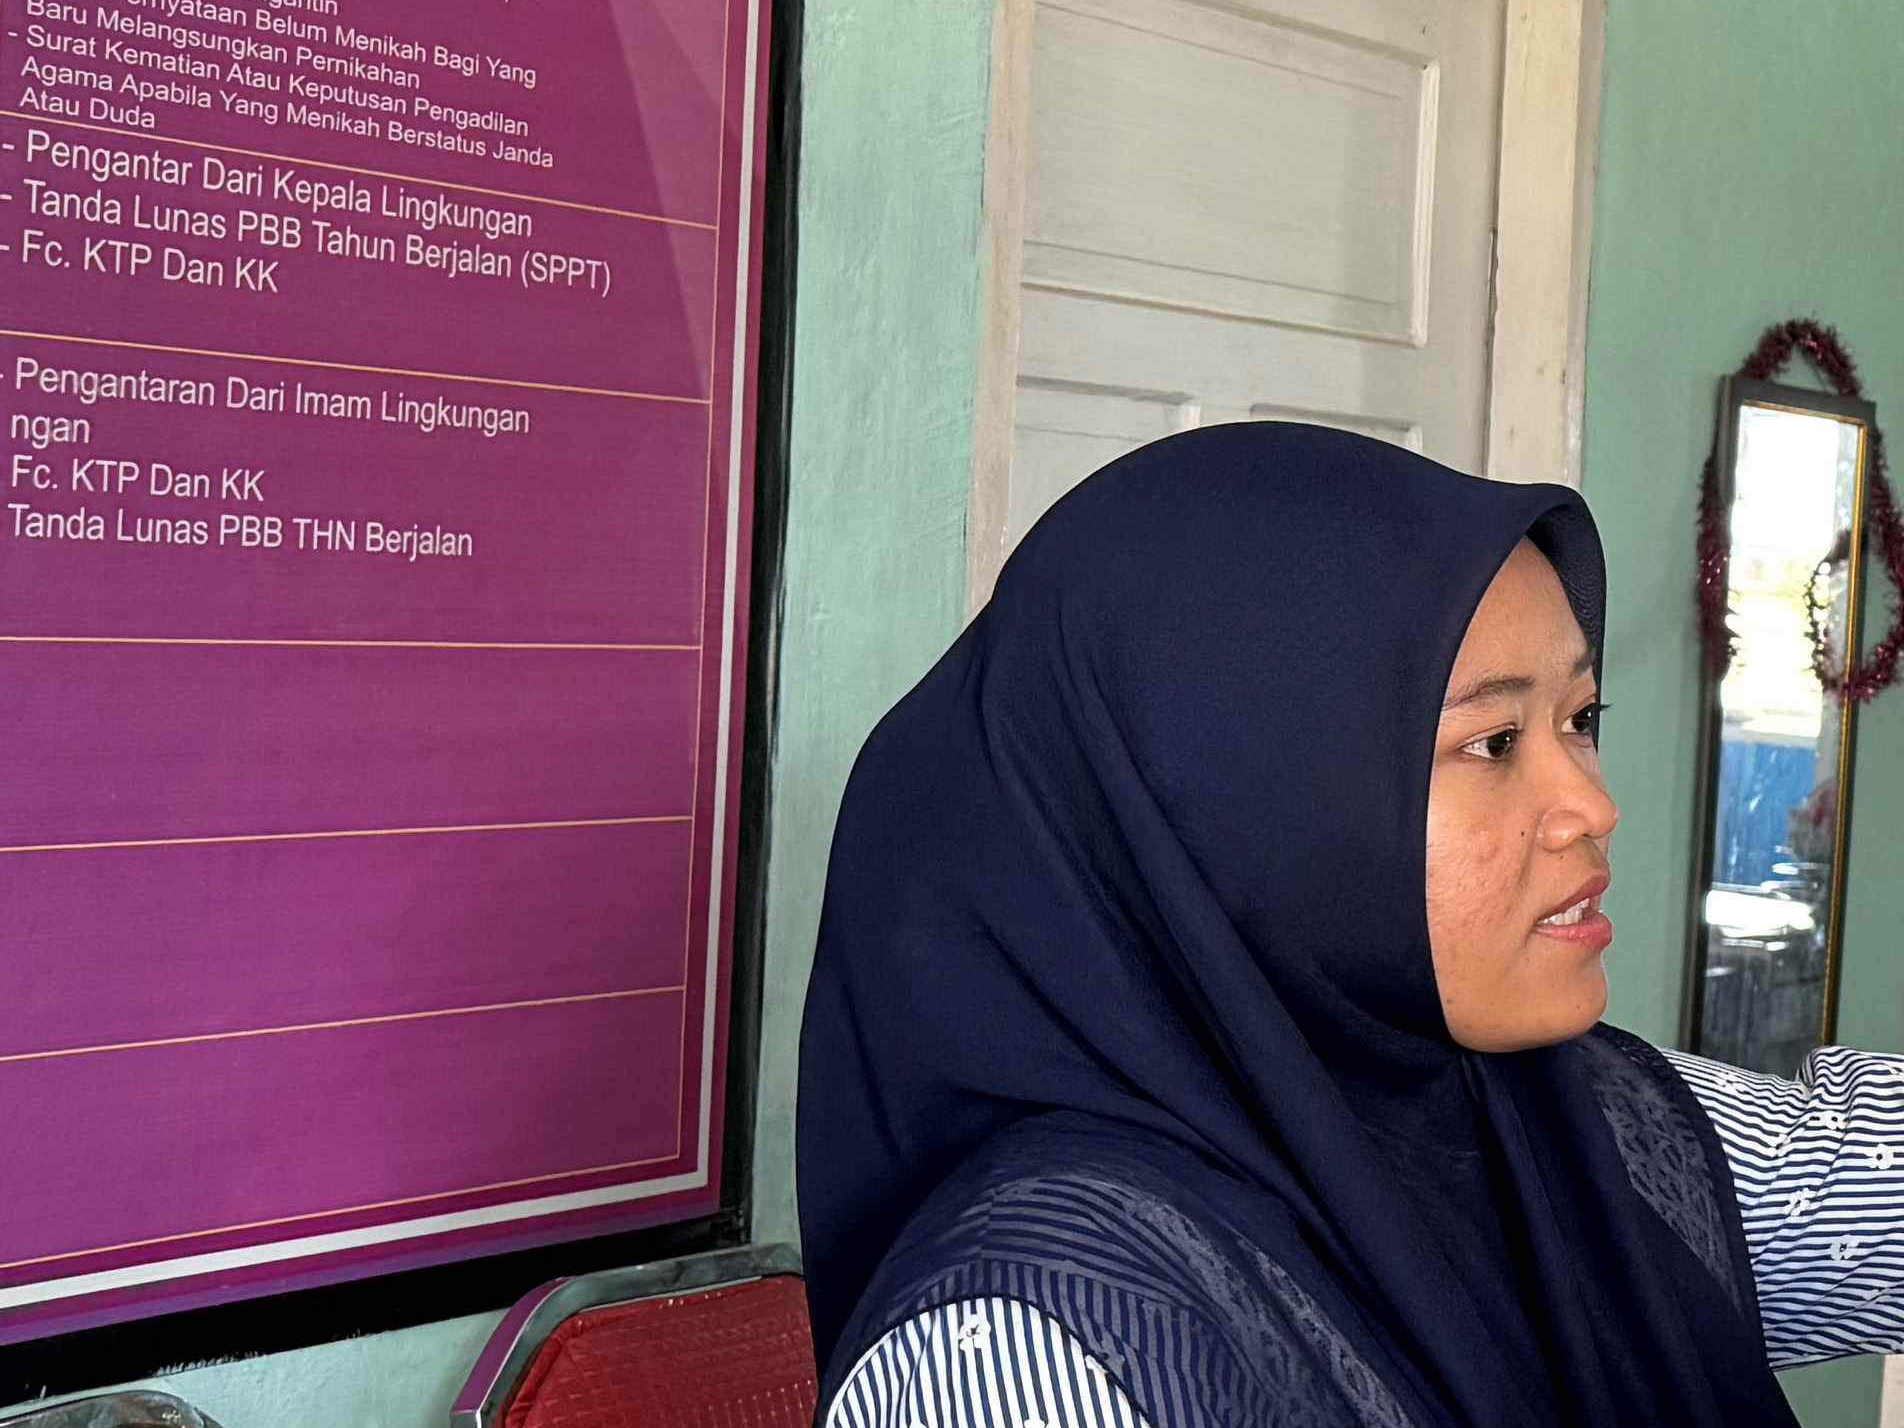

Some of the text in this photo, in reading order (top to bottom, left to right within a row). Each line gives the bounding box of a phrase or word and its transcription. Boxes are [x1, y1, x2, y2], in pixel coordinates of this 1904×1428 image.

[25, 23, 529, 137] Surat Kematian Atau Keputusan Pengadilan
[96, 5, 288, 64] Melangsungkan
[295, 45, 420, 89] Pernikahan
[254, 7, 327, 43] Belum
[334, 24, 426, 63] Menikah
[432, 44, 480, 77] Bagi
[485, 54, 536, 89] Yang
[18, 85, 155, 129] Atau Duda
[19, 54, 553, 168] Agama Apabila Yang Menikah Berstatus Janda
[26, 127, 532, 240] Pengantar Dari Kepala Lingkungan
[21, 228, 279, 293] Fc. KTP Dan KK
[22, 177, 611, 298] Tanda Lunas PBB Tahun Berjalan (SPPT)
[10, 413, 90, 450] ngan
[15, 355, 529, 438] Pengantaran Dari Imam Lingkungan
[11, 453, 265, 502] Fc. KTP Dan KK
[6, 502, 473, 562] Tanda Lunas PBB THN Berjalan
